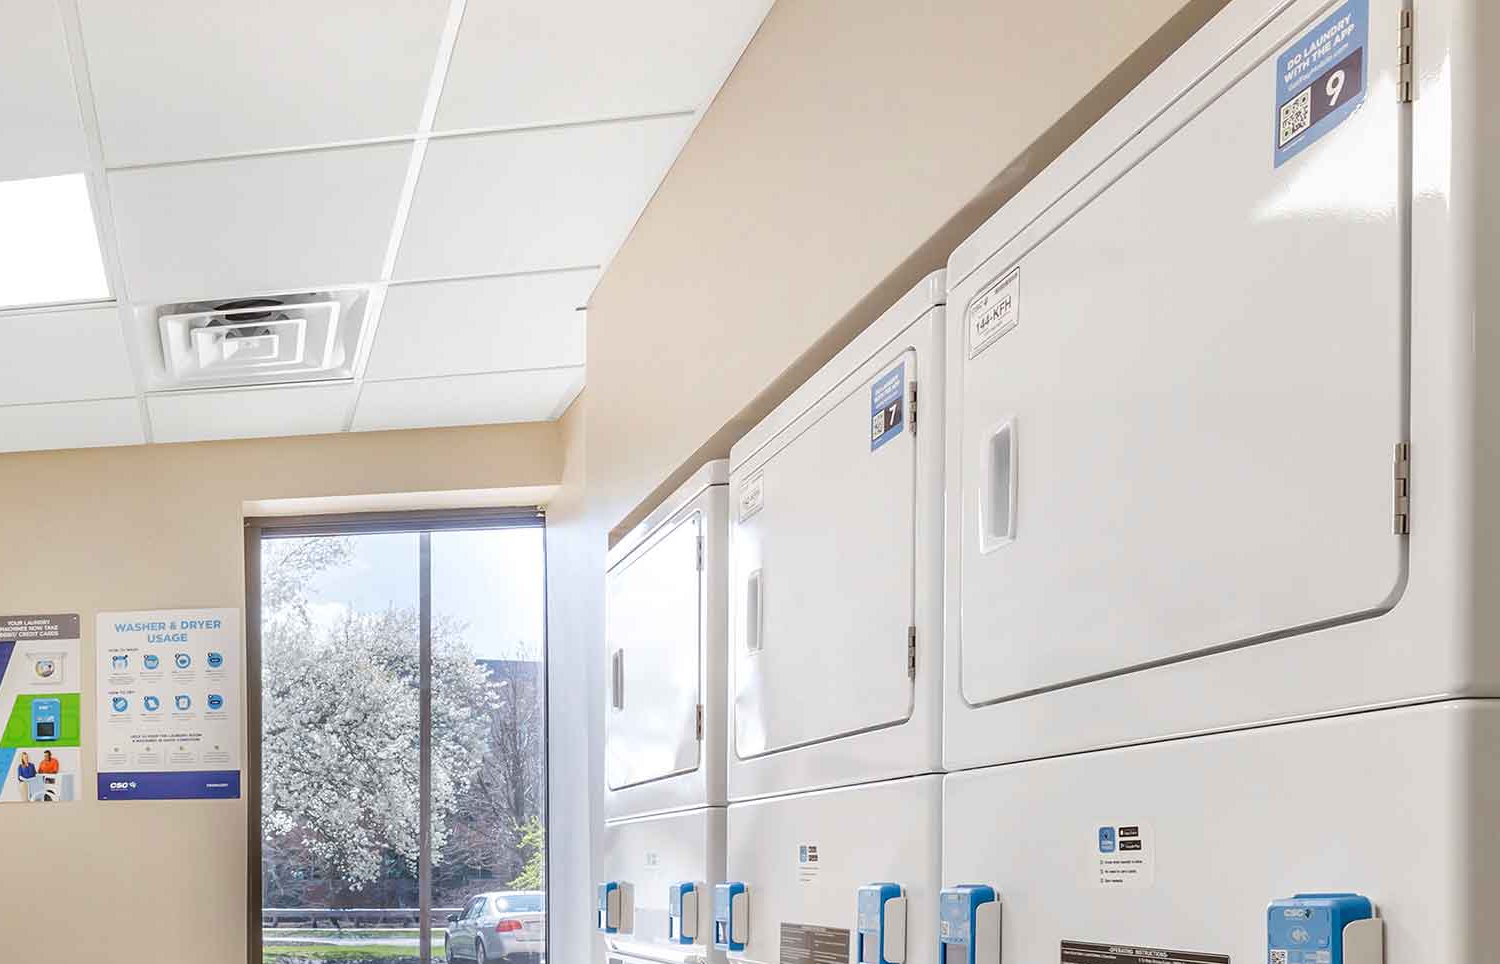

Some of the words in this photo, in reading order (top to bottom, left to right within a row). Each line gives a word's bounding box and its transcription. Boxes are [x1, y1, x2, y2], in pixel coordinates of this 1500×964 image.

[1284, 60, 1310, 84] WITH
[1312, 42, 1332, 63] THE
[1333, 24, 1355, 46] APP
[1287, 54, 1303, 71] DO
[1305, 13, 1351, 54] LAUNDRY
[1325, 69, 1345, 107] 9
[976, 295, 1011, 333] 144-KFH
[889, 404, 898, 426] 7
[115, 622, 166, 633] WASHER
[181, 620, 221, 630] DRYER
[147, 633, 188, 643] USAGE
